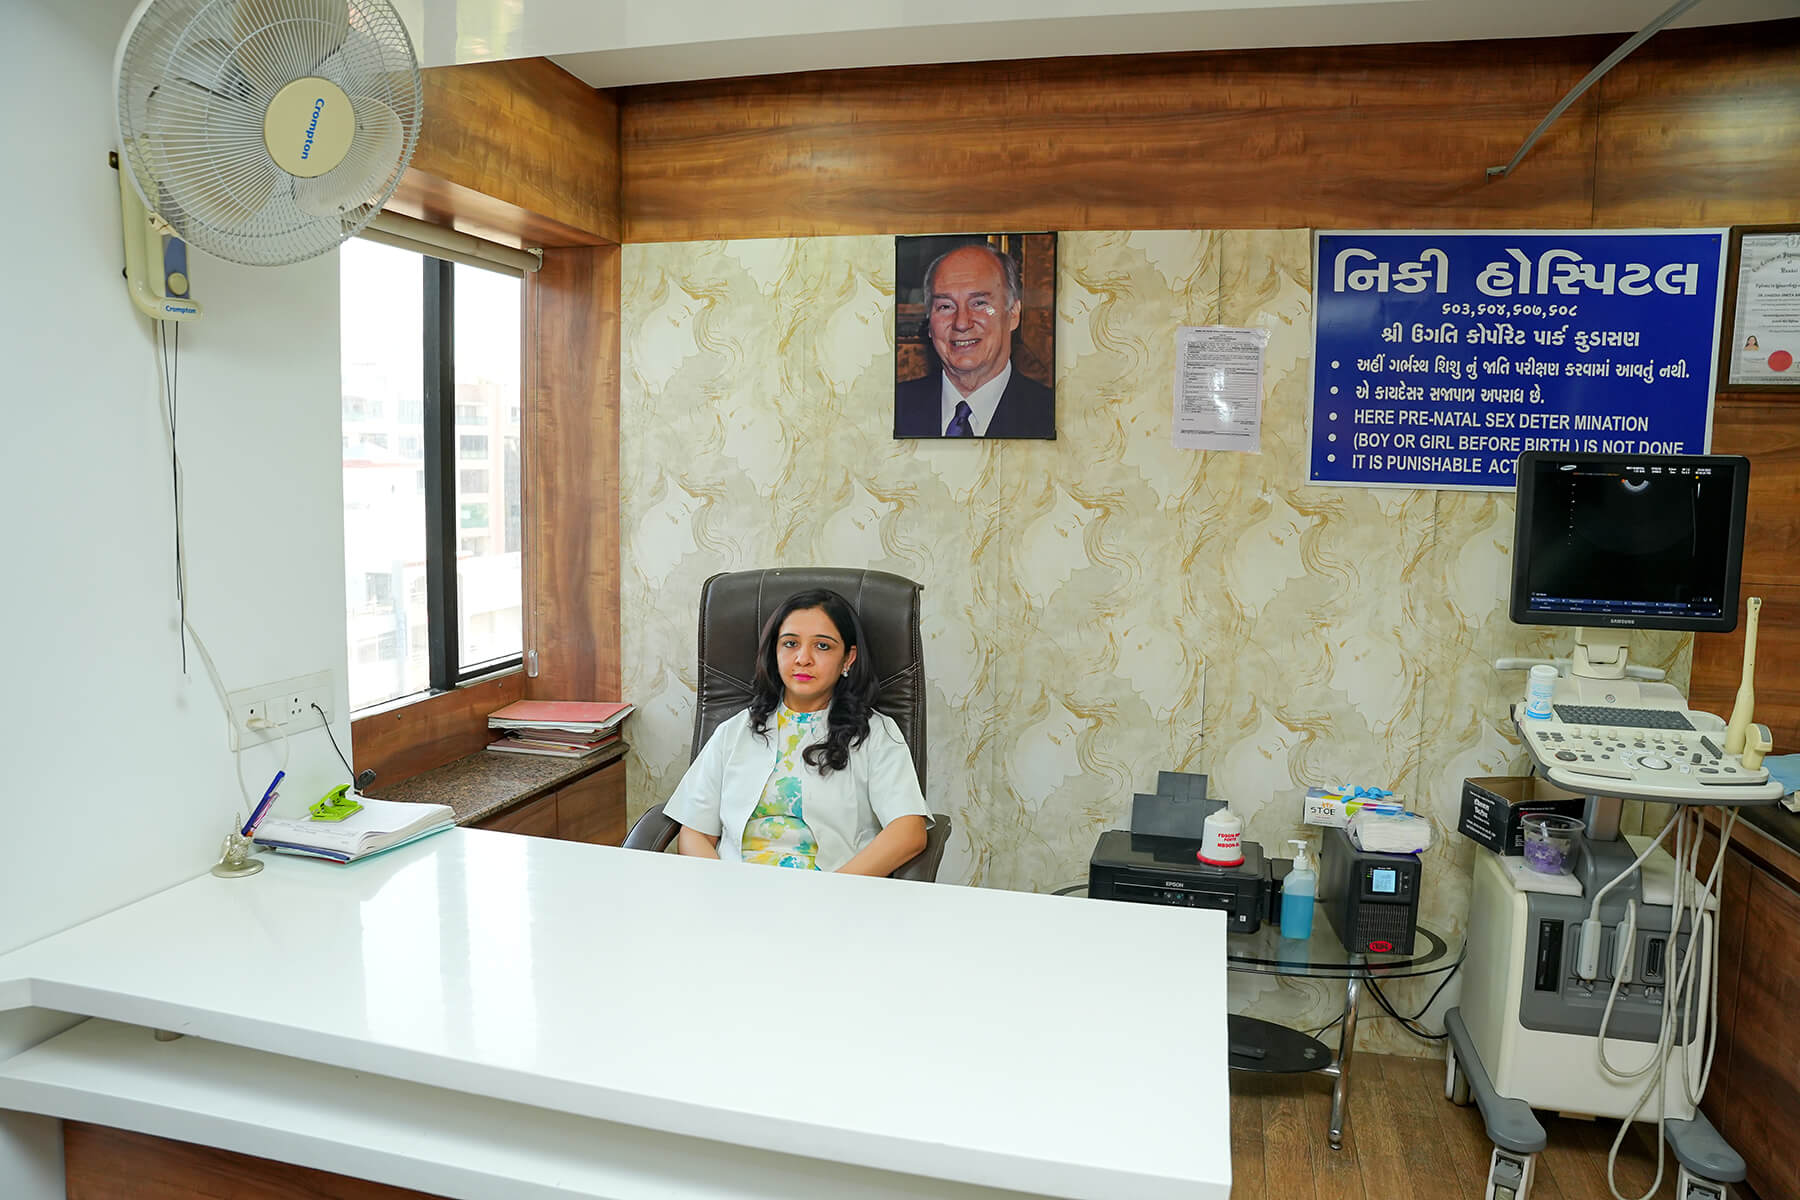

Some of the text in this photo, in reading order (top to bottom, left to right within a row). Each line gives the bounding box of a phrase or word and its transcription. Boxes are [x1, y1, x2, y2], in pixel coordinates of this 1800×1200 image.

[301, 98, 325, 159] Crompton
[1333, 248, 1449, 294] નિકી
[1476, 248, 1699, 297] હોસ્પિટલ
[165, 304, 197, 314] Crompton
[1381, 321, 1403, 343] શ્રી
[1411, 322, 1458, 344] ઉગતિ
[1533, 324, 1569, 346] પાર્ક
[1574, 331, 1640, 353] કુડાસણ
[1356, 353, 1386, 373] અહીં
[1388, 354, 1429, 373] ગર્ભસ્થ
[1434, 354, 1462, 380] શિશુ
[1465, 355, 1478, 380] નું
[1482, 356, 1510, 375] જાતિ
[1514, 356, 1560, 378] પરીક્ષણ
[1564, 358, 1610, 377] કરવામાં
[1615, 359, 1655, 384] આવતું
[1355, 379, 1370, 400] એ
[1374, 380, 1424, 401] કાયદેસર
[1429, 387, 1475, 403] સજાપાત્ર
[1480, 387, 1524, 404] અપરાધ
[1354, 408, 1649, 432] HERE PRE-NATAL SEX DETER MINATION
[1353, 432, 1391, 451] (BOY
[1393, 433, 1416, 449] OR
[1419, 434, 1455, 450] GIRL
[1458, 435, 1521, 452] BEFORE
[1524, 437, 1570, 452] BIRTH
[1583, 439, 1598, 453] IS
[1602, 439, 1636, 454] NOT
[1639, 441, 1684, 455] DONE
[1352, 454, 1366, 469] IT
[1369, 454, 1383, 470] IS
[1386, 455, 1482, 473] PUNISHABLE
